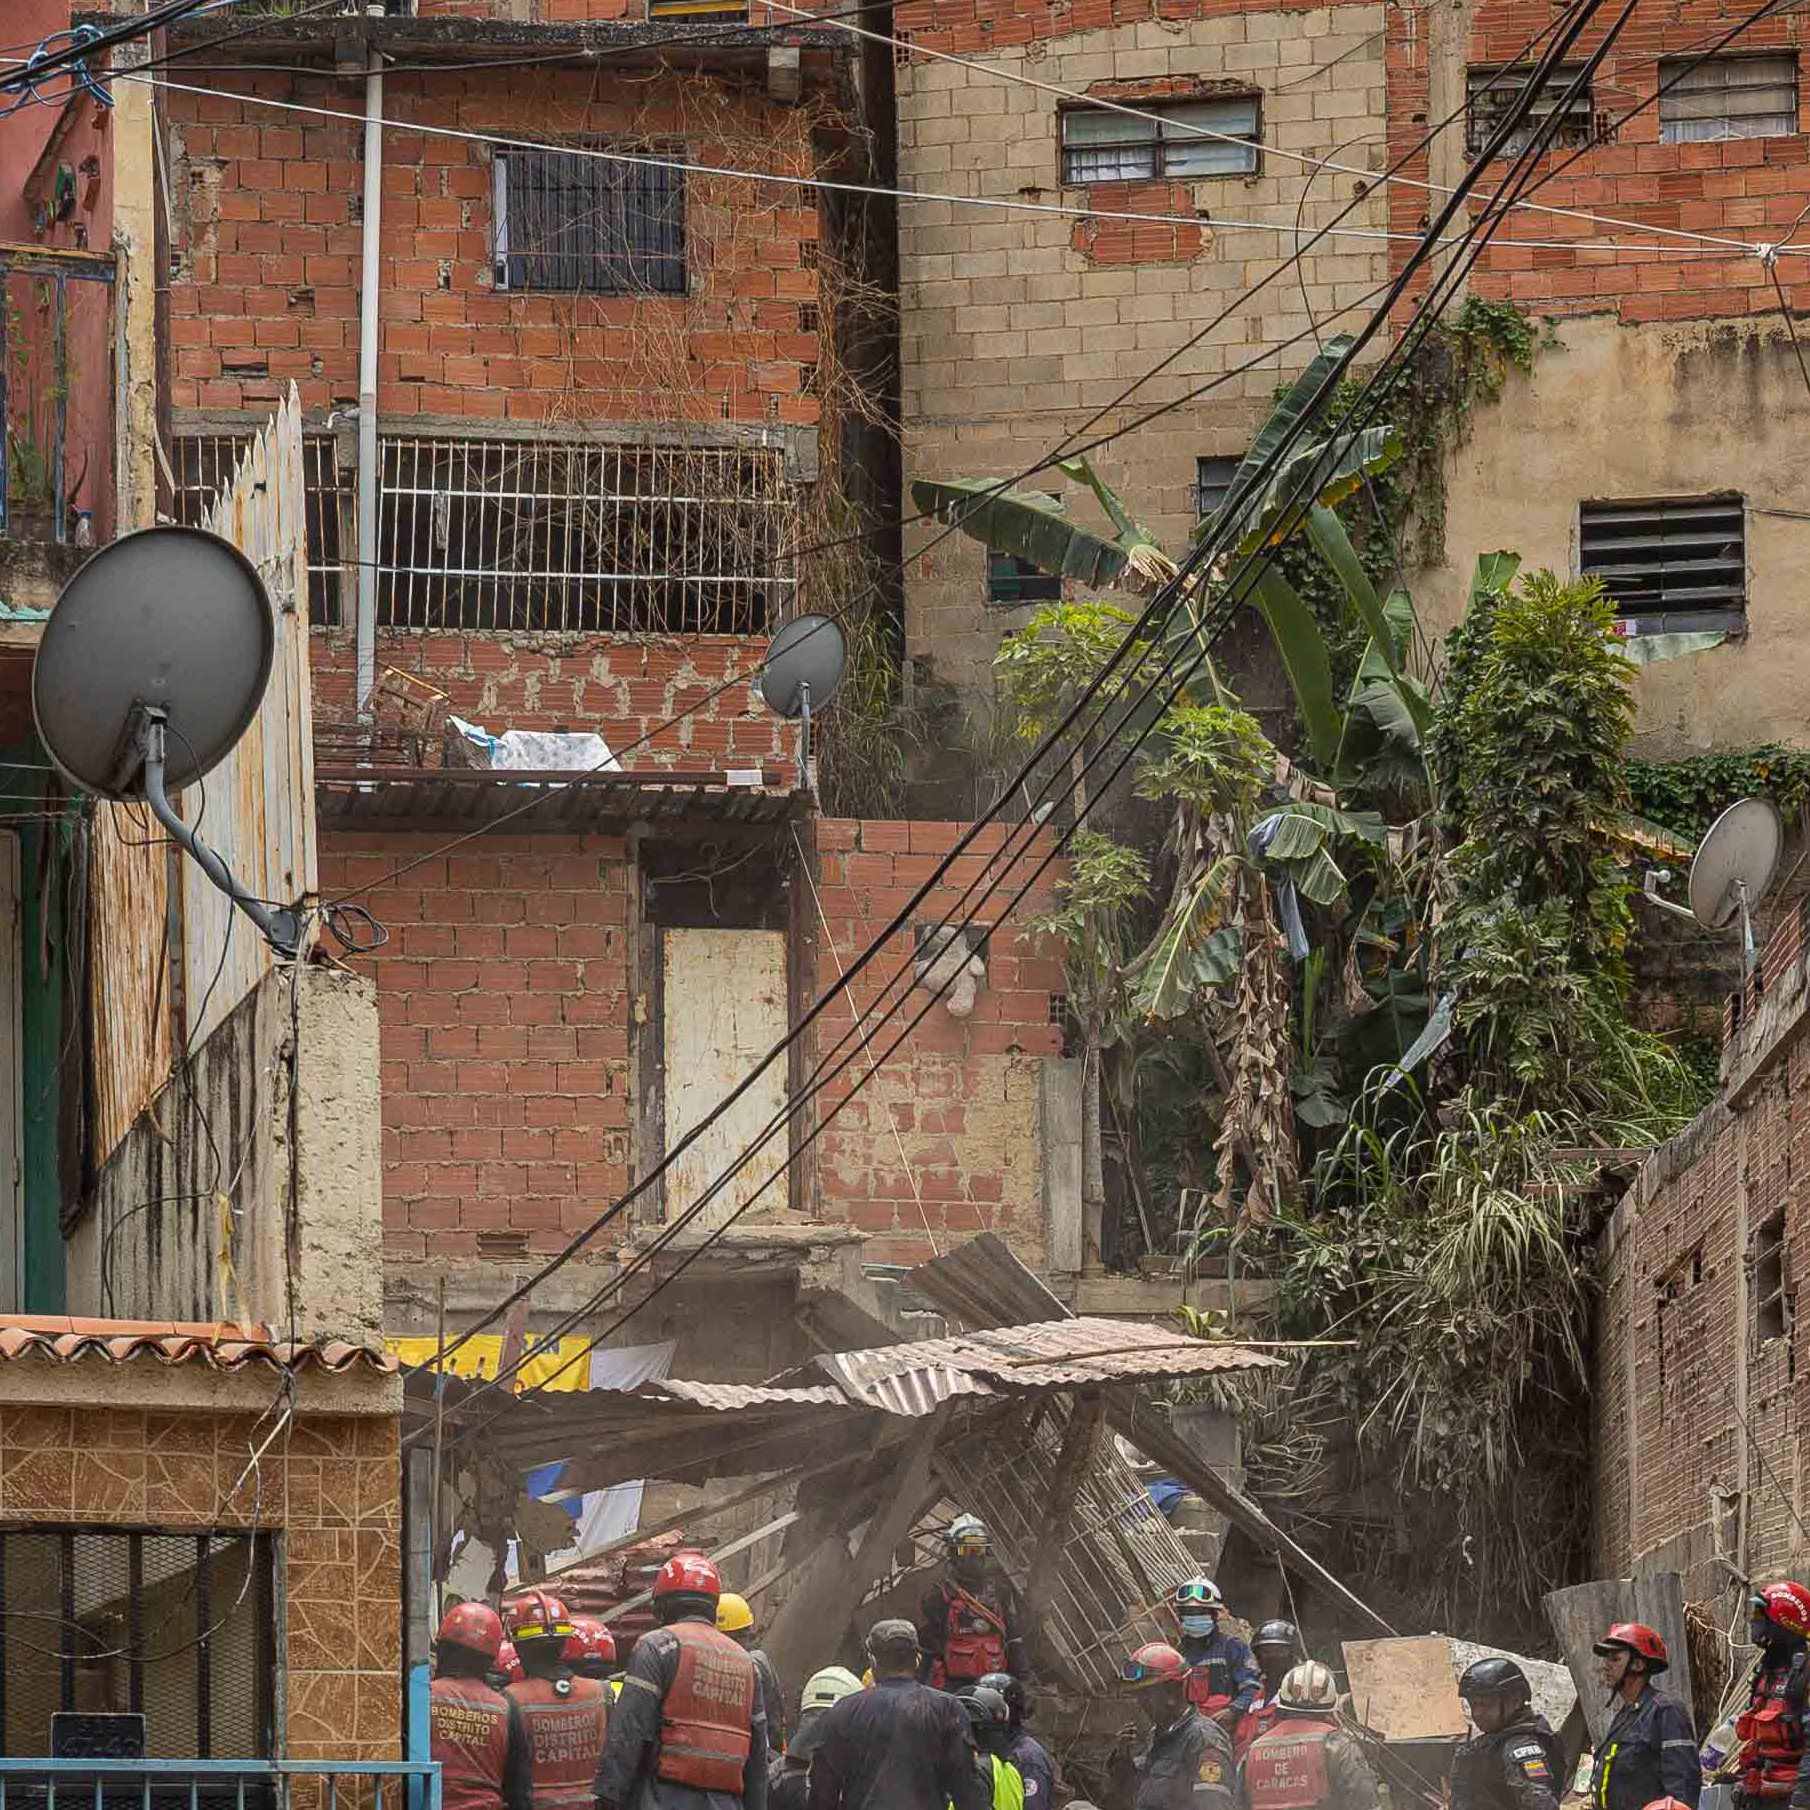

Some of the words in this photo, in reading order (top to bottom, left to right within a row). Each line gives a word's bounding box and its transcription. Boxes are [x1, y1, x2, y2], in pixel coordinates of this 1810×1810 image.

[430, 1706, 500, 1725] BOMBEROS
[437, 1717, 491, 1735] DISTRITO
[439, 1730, 489, 1747] CAPITAL
[535, 1747, 601, 1764] CAPITAL
